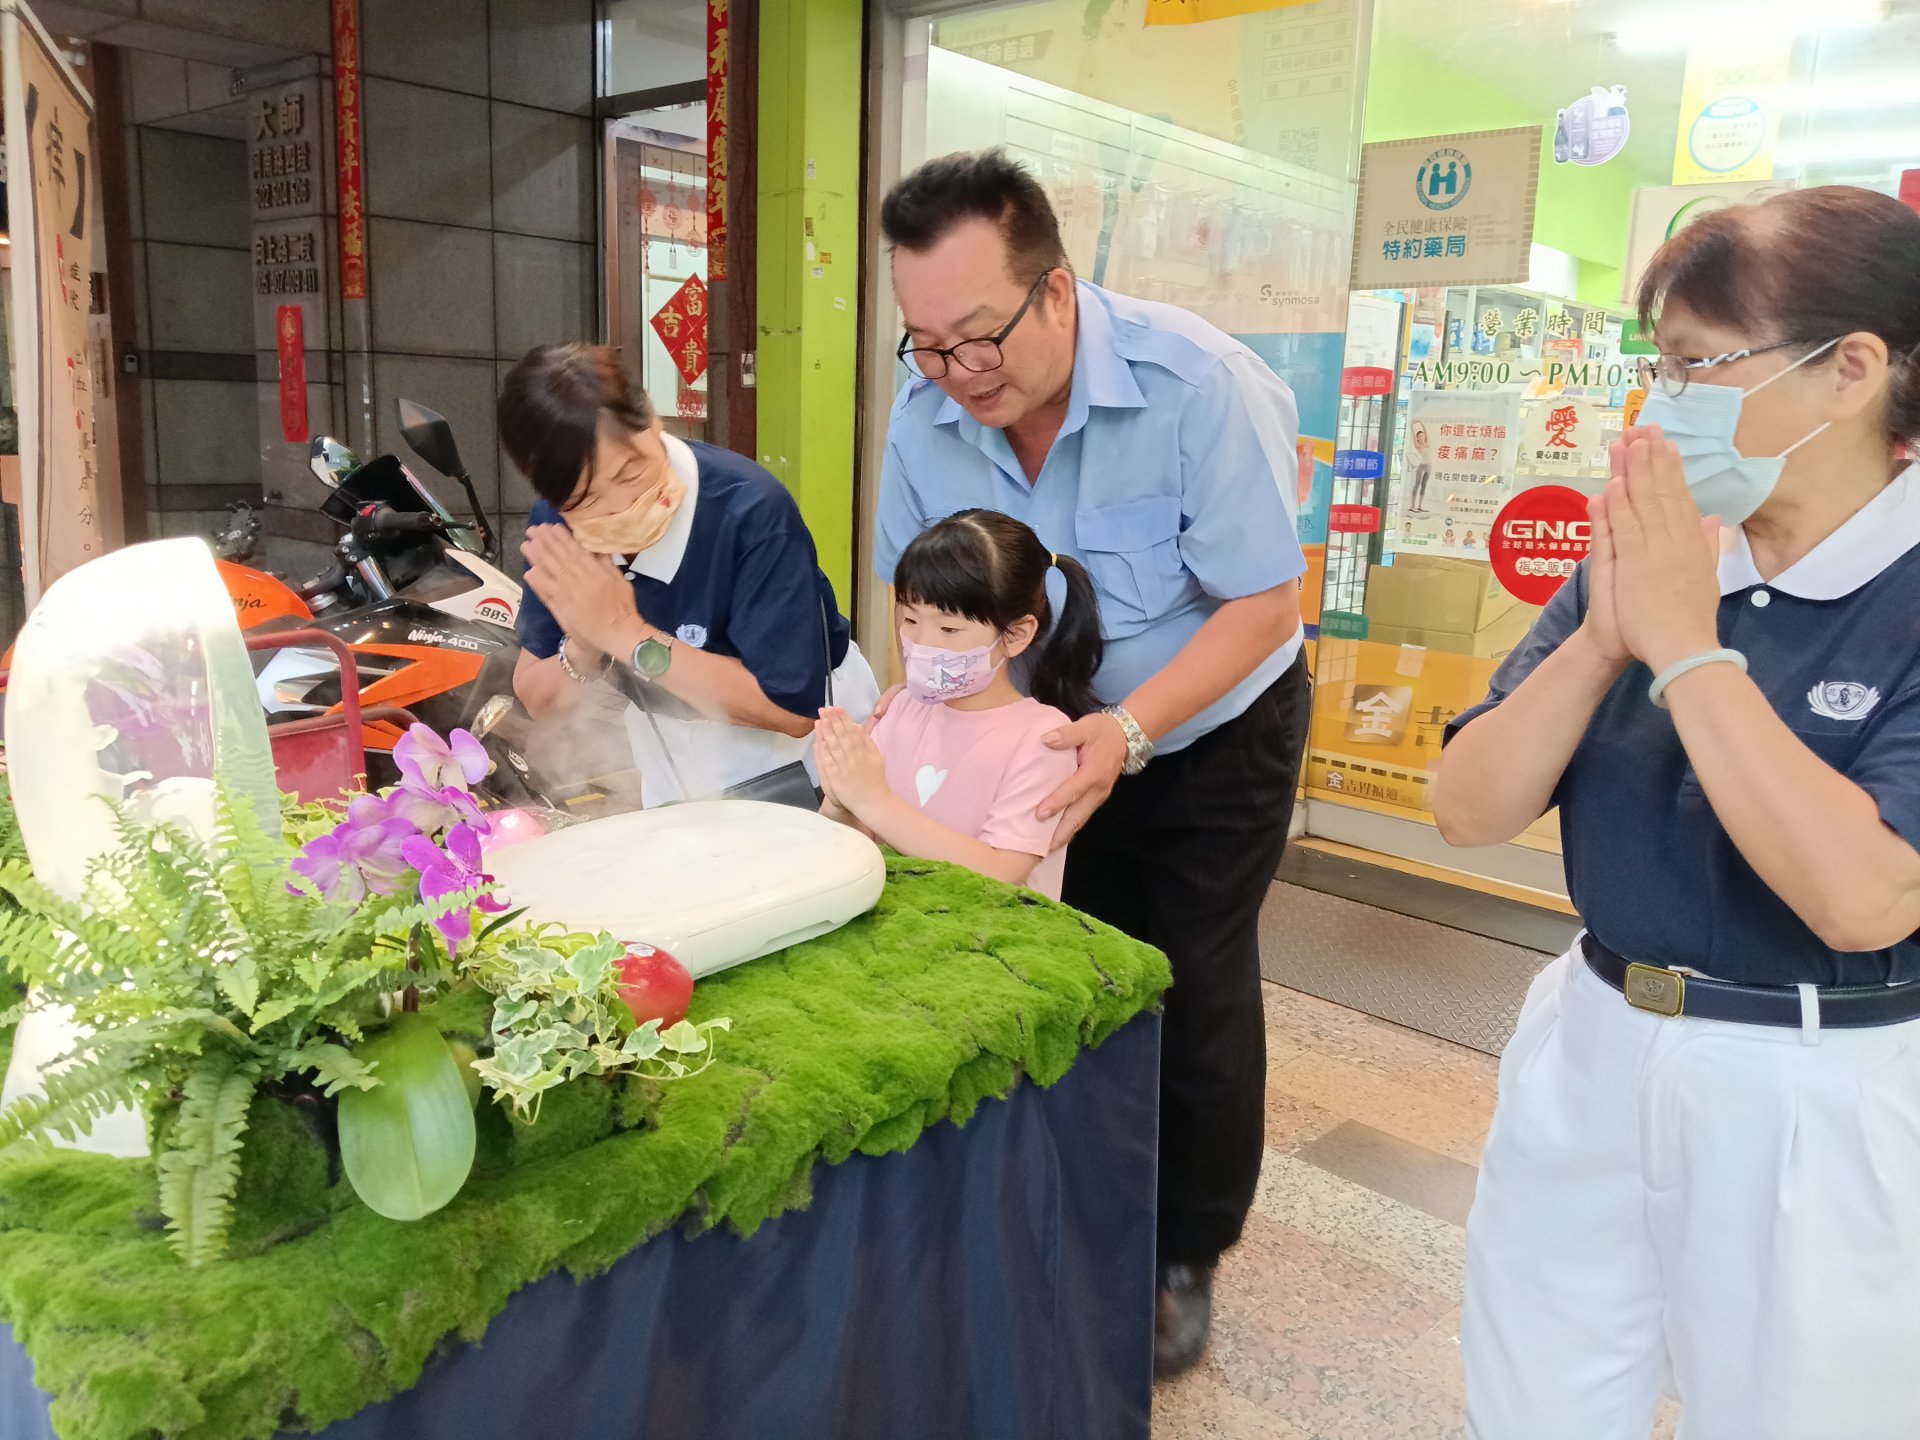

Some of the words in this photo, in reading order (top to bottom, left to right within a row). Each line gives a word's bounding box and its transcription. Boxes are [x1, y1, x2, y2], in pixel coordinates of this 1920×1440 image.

[252, 94, 305, 140] 大師
[1383, 216, 1468, 236] 全民健康保險
[255, 233, 315, 265] 向上路二段
[1382, 235, 1467, 261] 特約藥局
[1272, 296, 1321, 308] synmosa
[1481, 308, 1606, 337] 營業時間
[1413, 361, 1511, 385] AM9:00
[1548, 363, 1643, 388] PM10:
[1440, 424, 1506, 440] 你還在煩惱
[1502, 519, 1592, 540] GNC
[408, 630, 445, 645] Ninja
[447, 638, 478, 651] 400
[1354, 691, 1404, 738] 金
